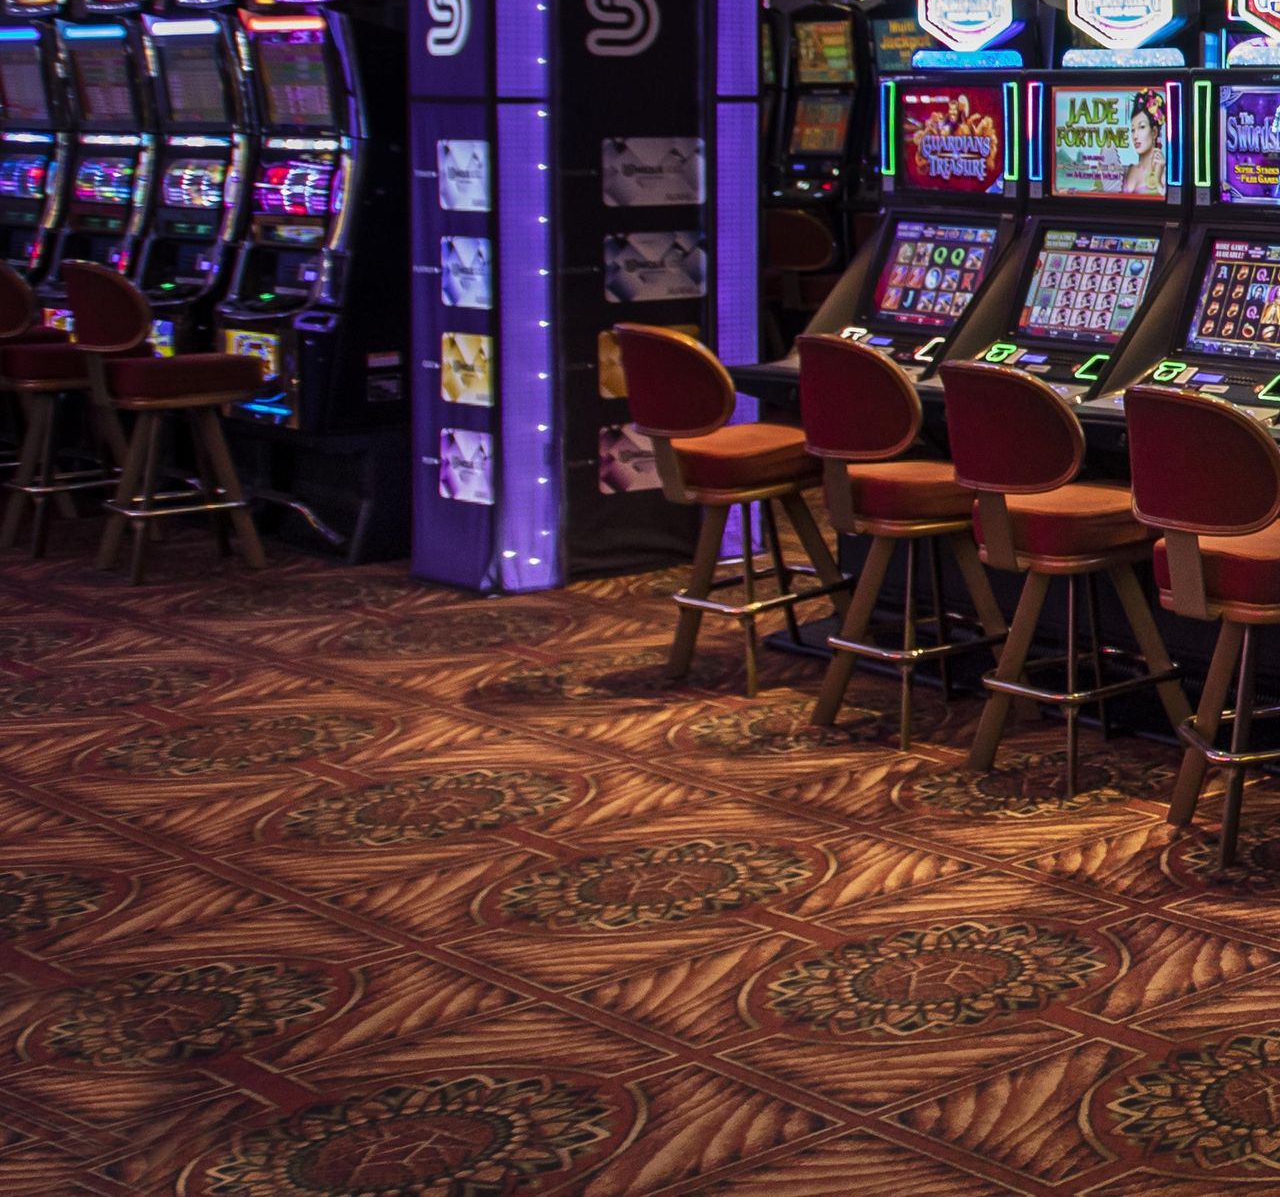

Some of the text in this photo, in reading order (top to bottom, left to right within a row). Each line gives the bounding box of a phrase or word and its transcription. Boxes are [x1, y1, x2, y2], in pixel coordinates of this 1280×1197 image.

[1067, 97, 1120, 126] JADE
[1238, 112, 1255, 126] The
[920, 135, 991, 158] GUARDIANS
[1056, 125, 1131, 149] FORTUNE
[927, 155, 989, 182] TREASURE
[933, 246, 966, 266] Q Q
[1215, 242, 1249, 251] MORE GAMES
[1217, 265, 1228, 279] A
[902, 290, 915, 307] J
